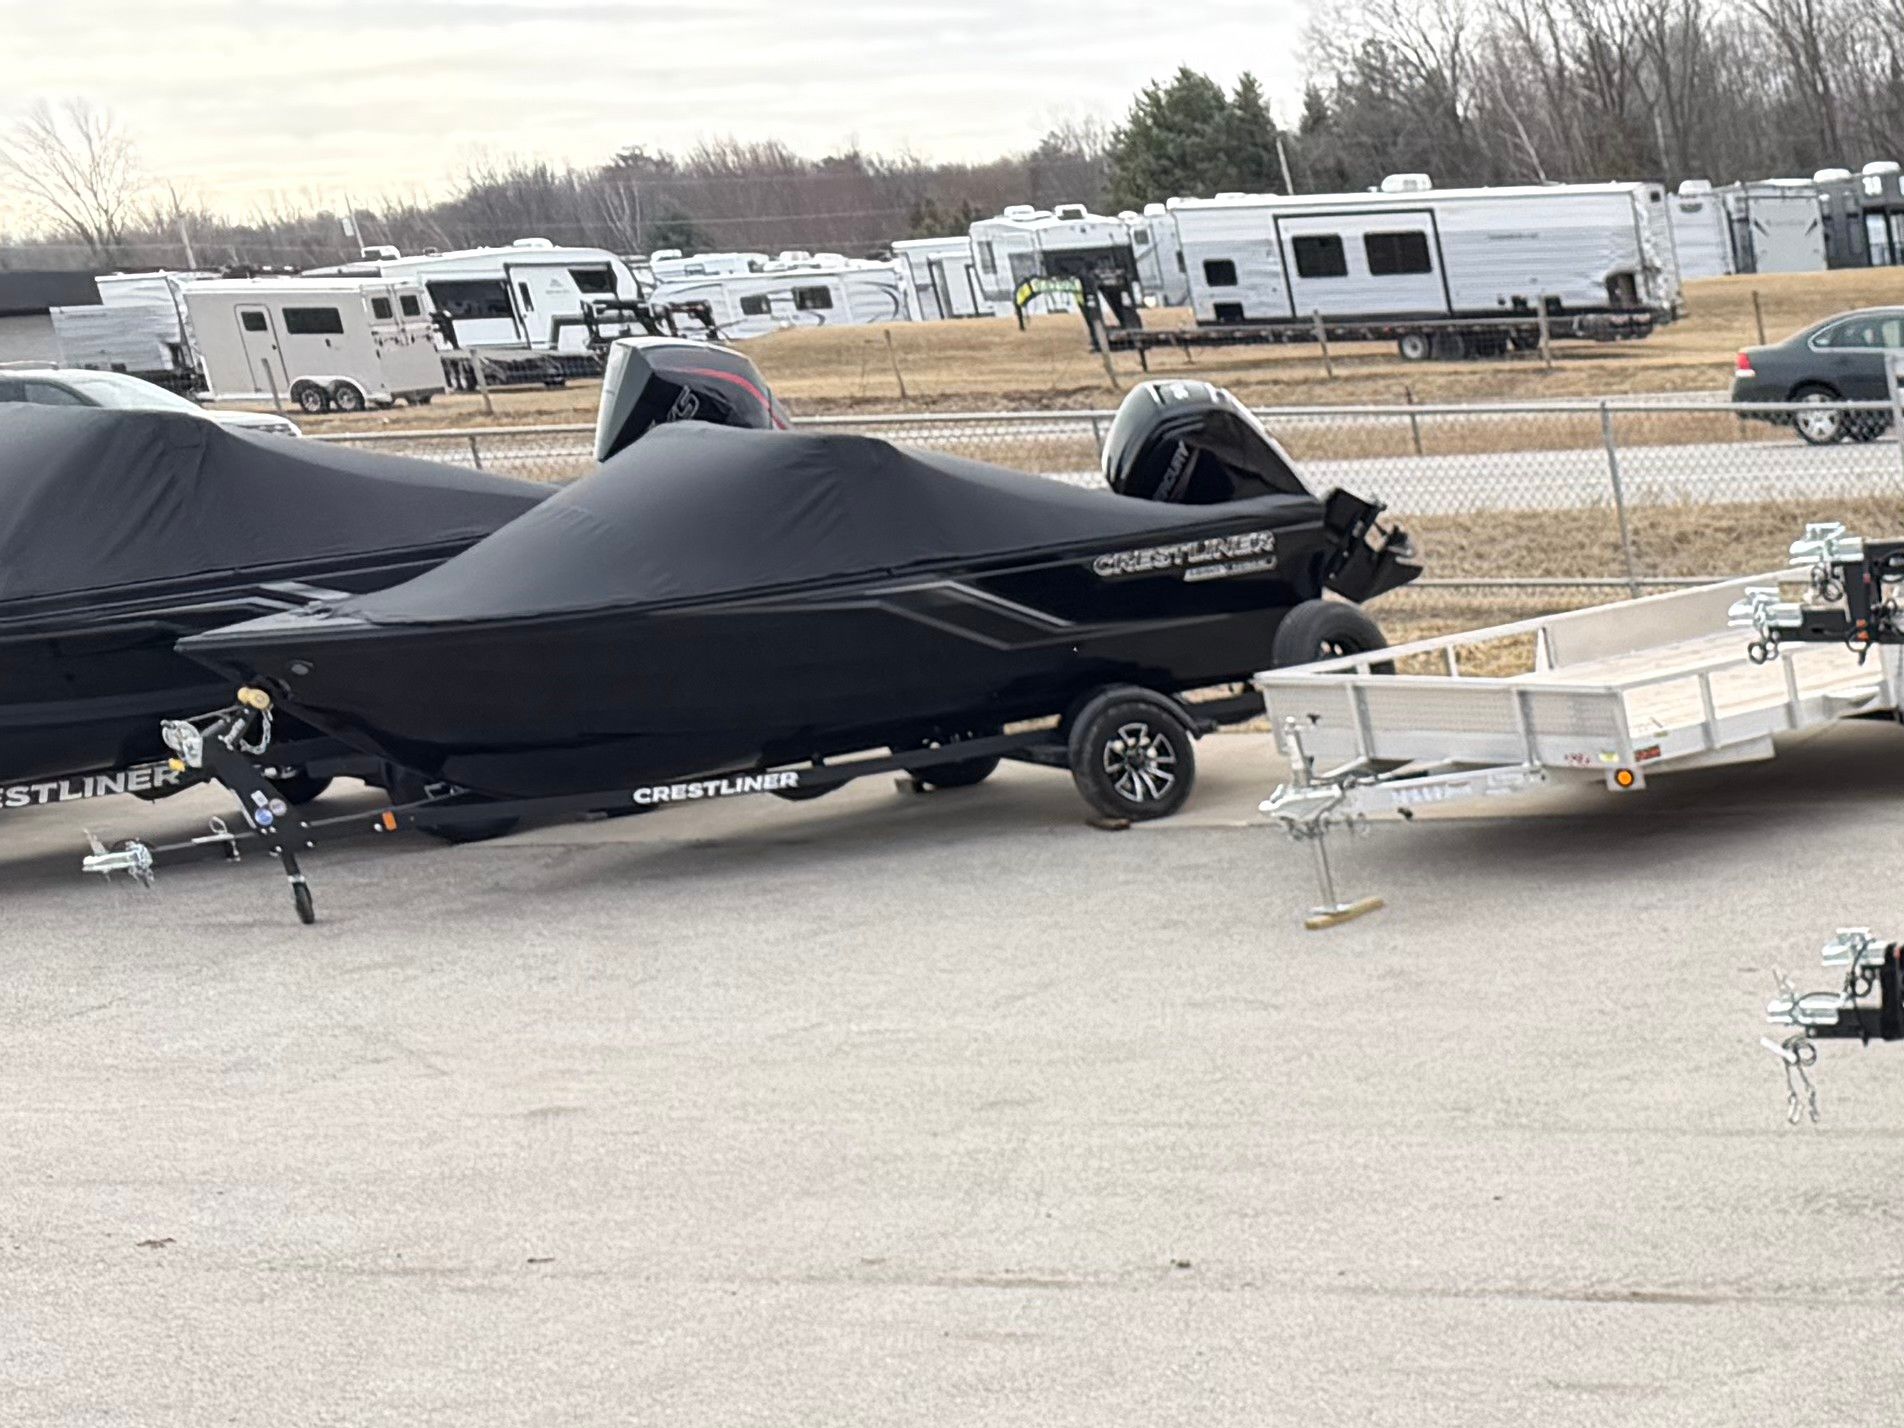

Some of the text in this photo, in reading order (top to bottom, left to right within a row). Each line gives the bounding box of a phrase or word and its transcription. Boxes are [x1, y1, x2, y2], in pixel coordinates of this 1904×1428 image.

[1093, 530, 1276, 577] CRESTLINER
[0, 765, 181, 809] STLINER
[633, 771, 800, 805] CRESTLINER
